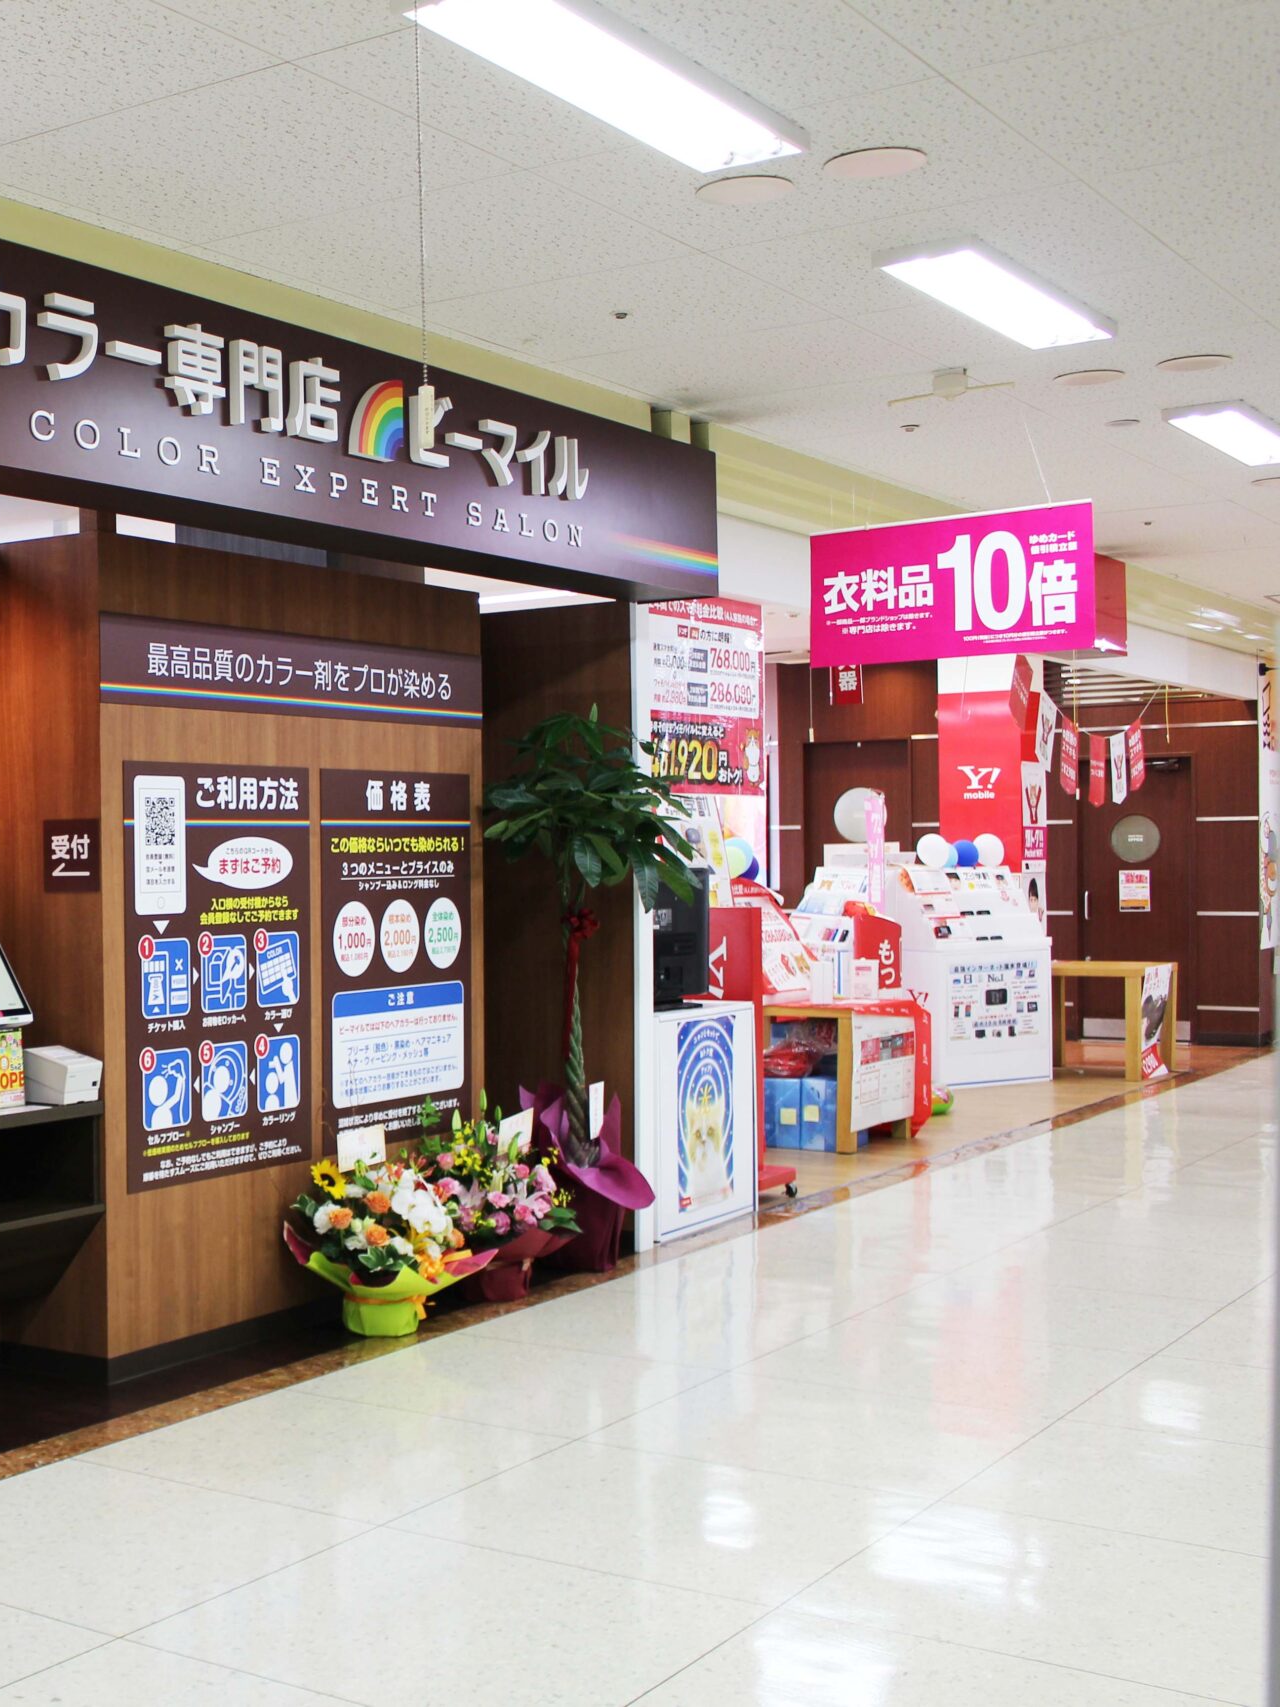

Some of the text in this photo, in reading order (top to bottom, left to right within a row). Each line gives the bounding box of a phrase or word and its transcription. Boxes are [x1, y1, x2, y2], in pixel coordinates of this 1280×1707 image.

[30, 409, 221, 476] COLOR
[260, 457, 437, 518] EXPERT
[467, 502, 583, 548] SALON
[1029, 531, 1076, 544] ゆめカード
[823, 564, 934, 615] 衣料品
[147, 641, 453, 701] 最高品質のカラー剤をプロが染める
[195, 776, 299, 811] ご利用方法
[365, 779, 431, 812] 価格表
[963, 789, 995, 800] mobile
[51, 834, 90, 861] 受付
[218, 857, 281, 875] まずはご予約
[258, 933, 265, 949] 3
[338, 932, 371, 950] 1,000円
[384, 929, 416, 946] 2,000円
[428, 927, 458, 943] 2,500円
[143, 941, 150, 956] 1
[203, 937, 209, 952] 2
[387, 991, 415, 1006] ご注意
[203, 1046, 210, 1061] 5
[258, 1038, 265, 1053] 4
[144, 1053, 151, 1068] 6
[262, 1112, 296, 1126] カラーリング
[210, 1122, 240, 1135] シャンプー
